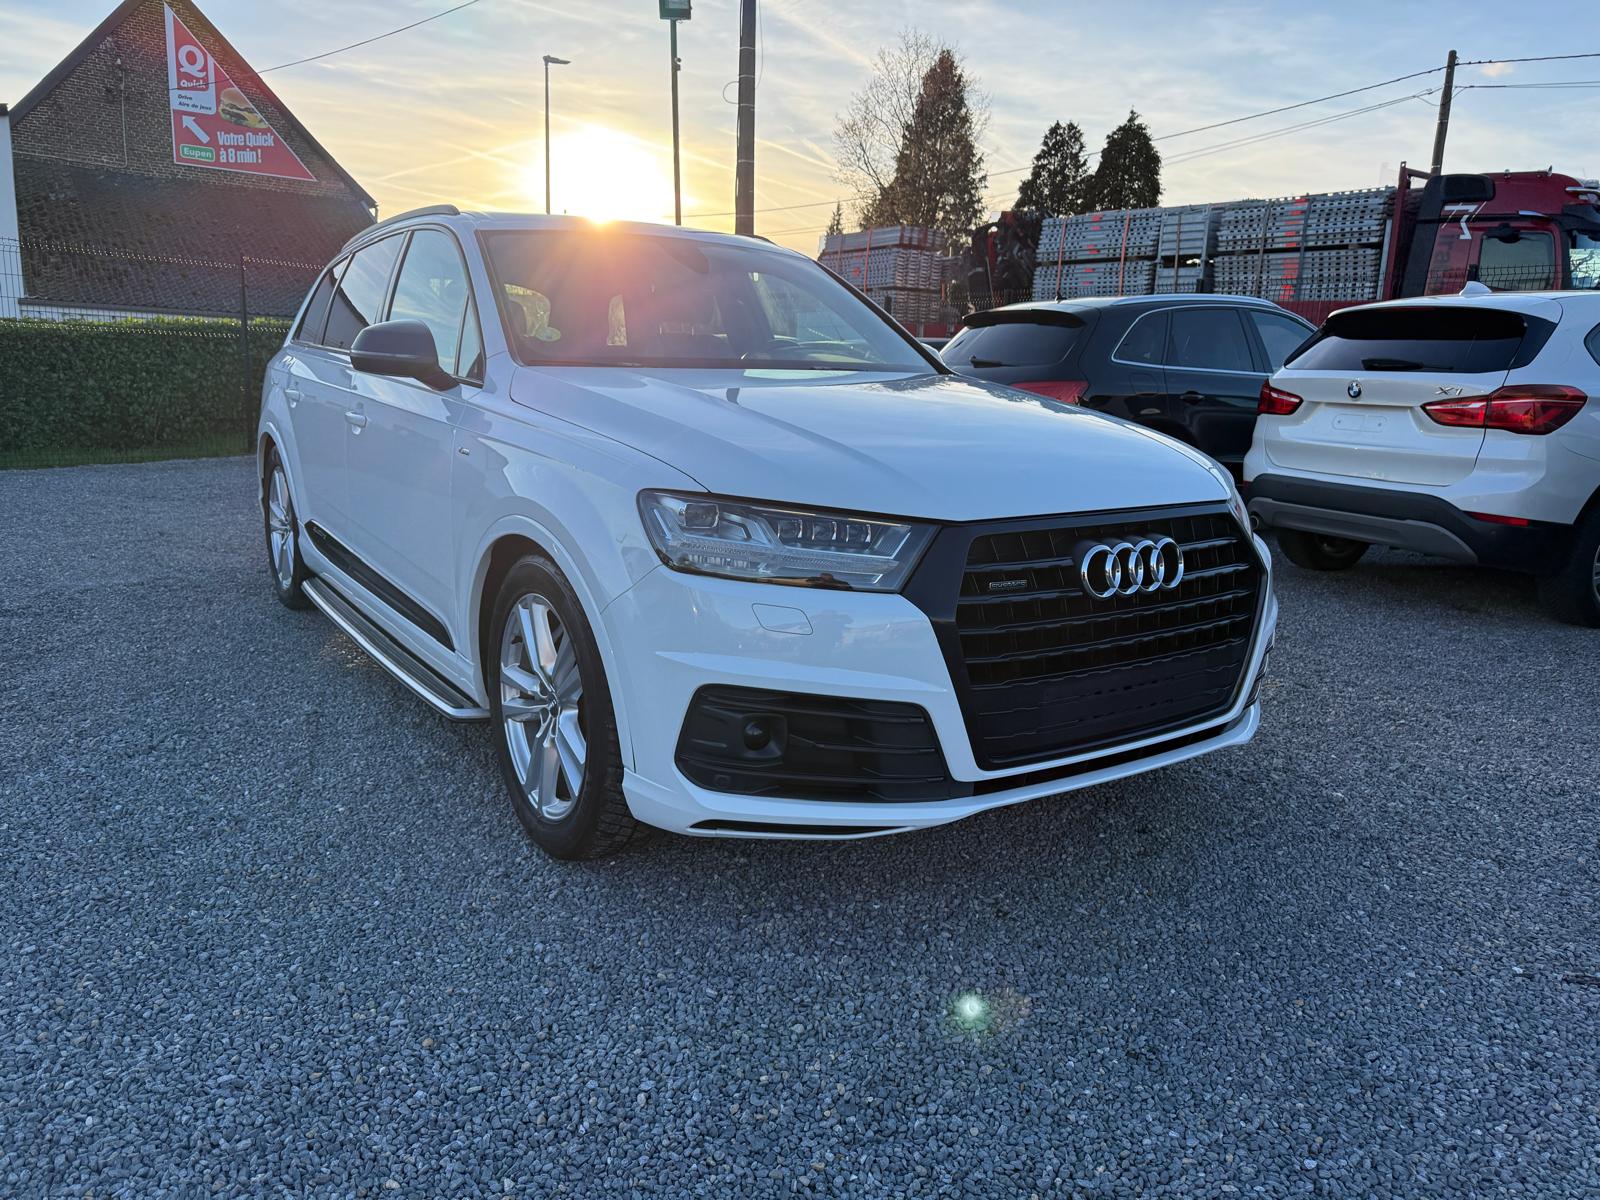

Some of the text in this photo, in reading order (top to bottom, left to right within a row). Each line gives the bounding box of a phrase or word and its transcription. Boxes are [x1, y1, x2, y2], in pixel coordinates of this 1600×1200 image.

[180, 80, 206, 88] Quick
[217, 131, 274, 147] Votre Quick
[184, 147, 212, 158] Eupen
[220, 148, 226, 162] à
[228, 148, 235, 162] 8
[237, 149, 256, 163] min
[1435, 387, 1463, 396] X1
